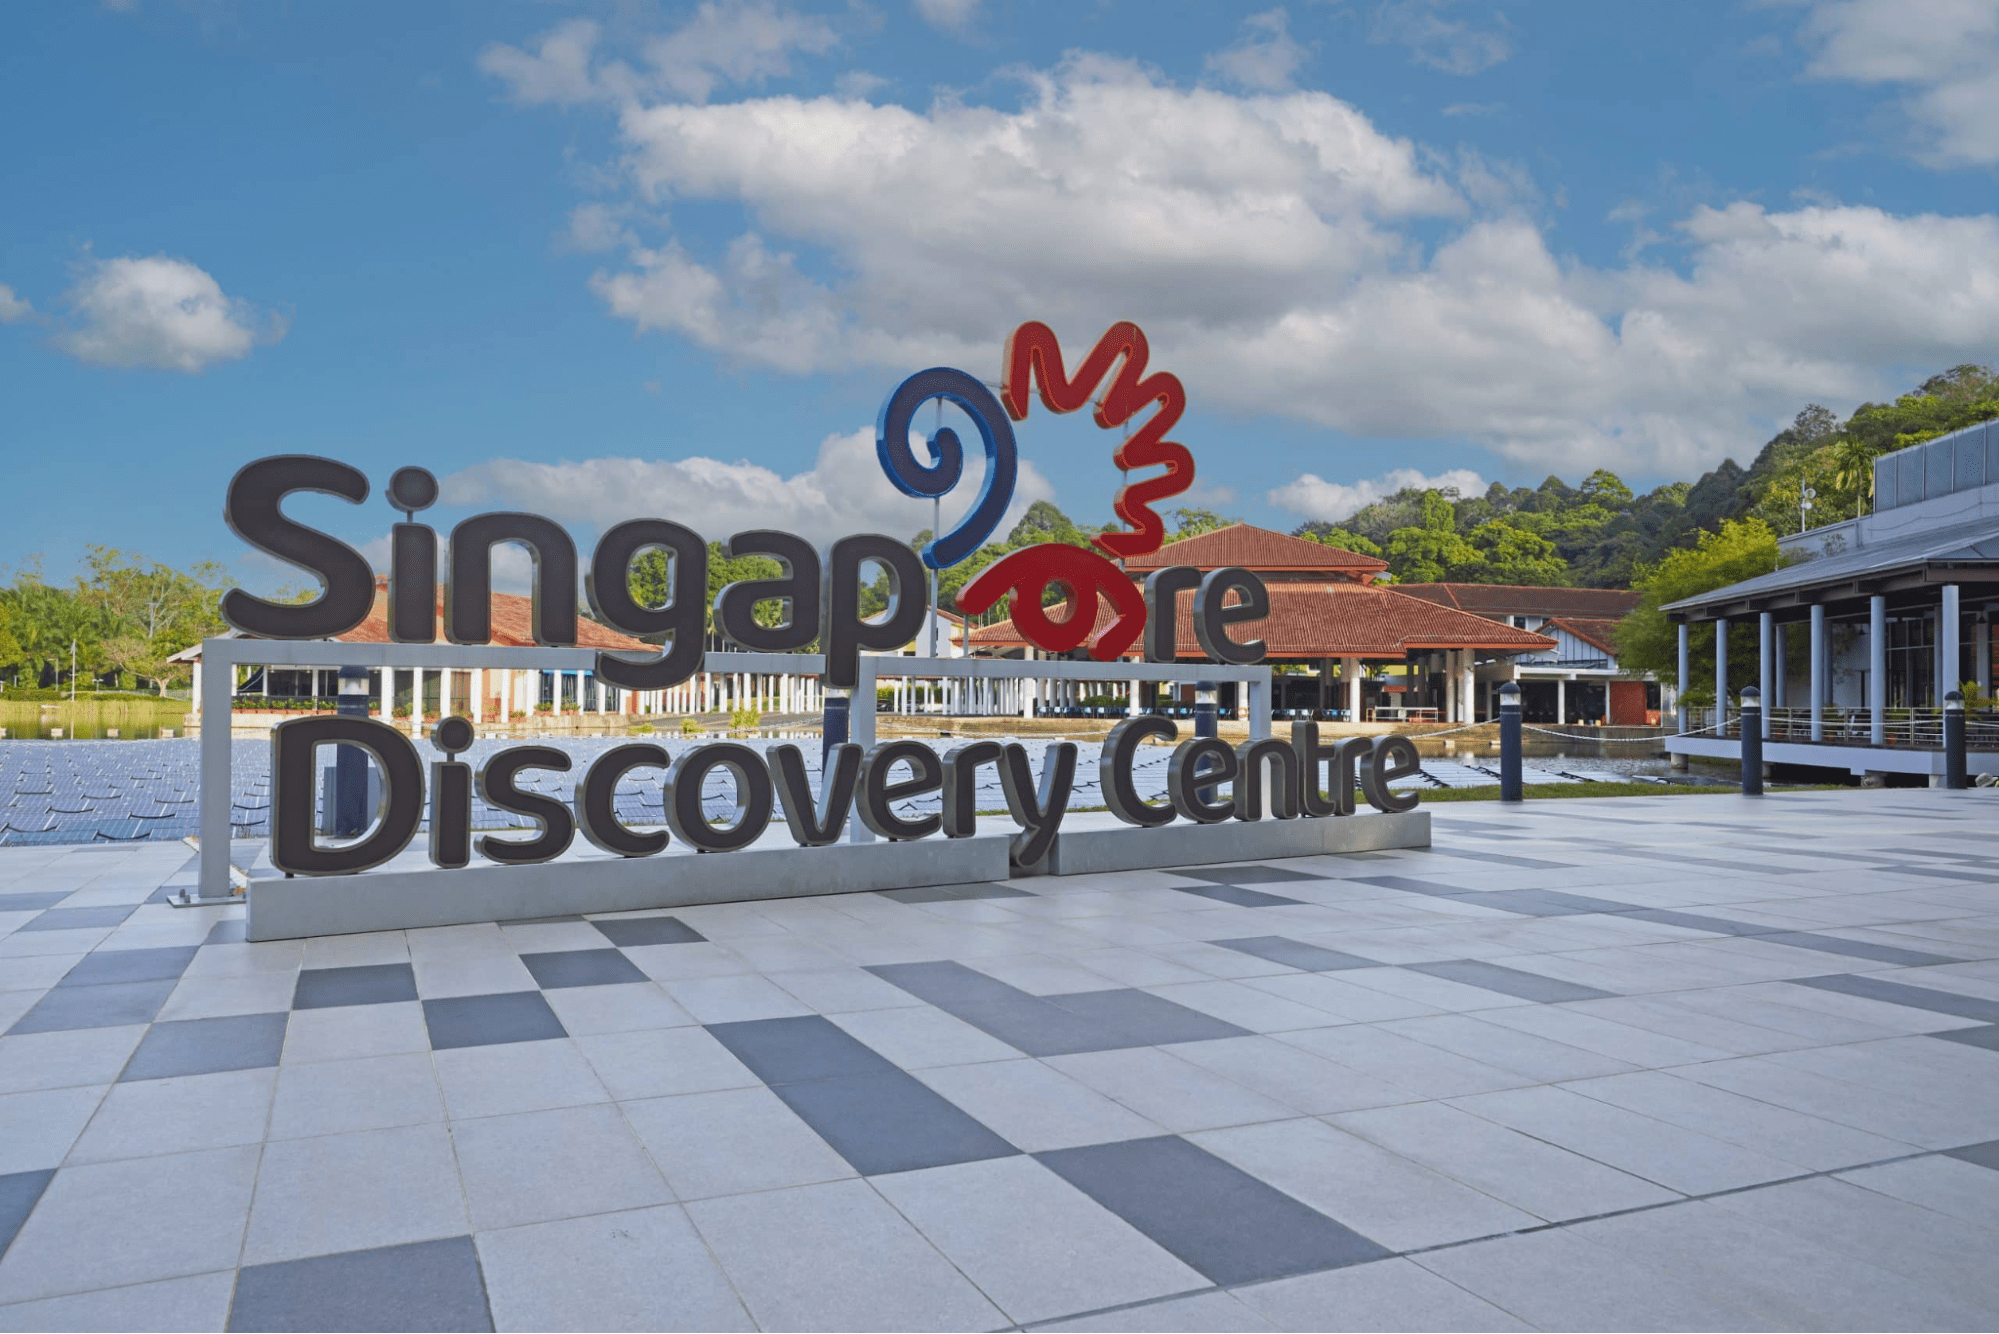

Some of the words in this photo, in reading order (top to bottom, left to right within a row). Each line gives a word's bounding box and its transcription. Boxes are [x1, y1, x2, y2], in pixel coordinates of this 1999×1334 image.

[221, 453, 1269, 690] Singapore
[270, 715, 1078, 868] Discovery
[1100, 715, 1420, 828] Centre
